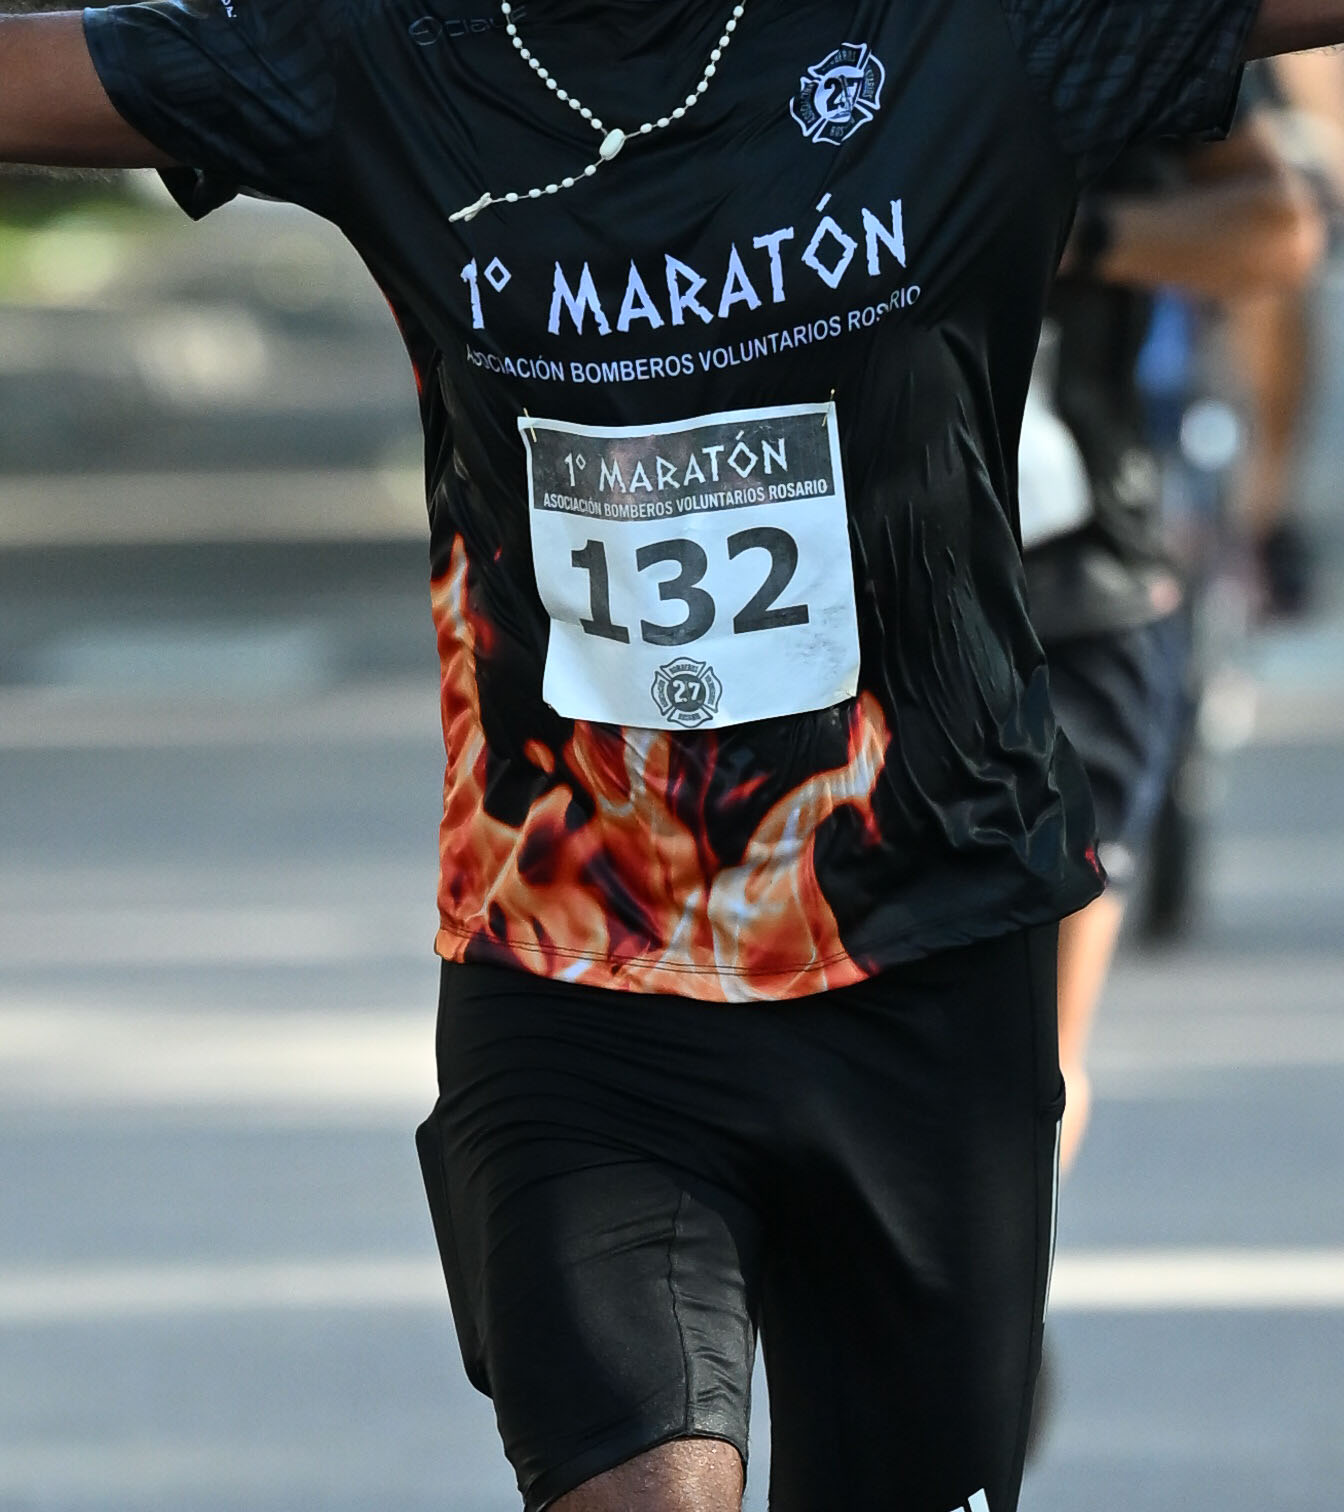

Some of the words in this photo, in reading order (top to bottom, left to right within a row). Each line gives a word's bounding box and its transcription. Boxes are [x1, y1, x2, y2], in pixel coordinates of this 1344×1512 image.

[548, 192, 906, 336] MARATÓN
[570, 353, 694, 384] BOMBEROS
[698, 316, 841, 372] VOLUNTARIOS
[848, 285, 921, 332] ROSRIO
[543, 492, 602, 515] ASOCIACIÓN
[605, 500, 673, 518] BOMBEROS
[676, 488, 765, 512] VOLUNTARIOS
[769, 478, 828, 501] ROSARIO
[599, 430, 788, 493] MARATÓN
[571, 526, 810, 646] 132
[672, 679, 701, 703] 27
